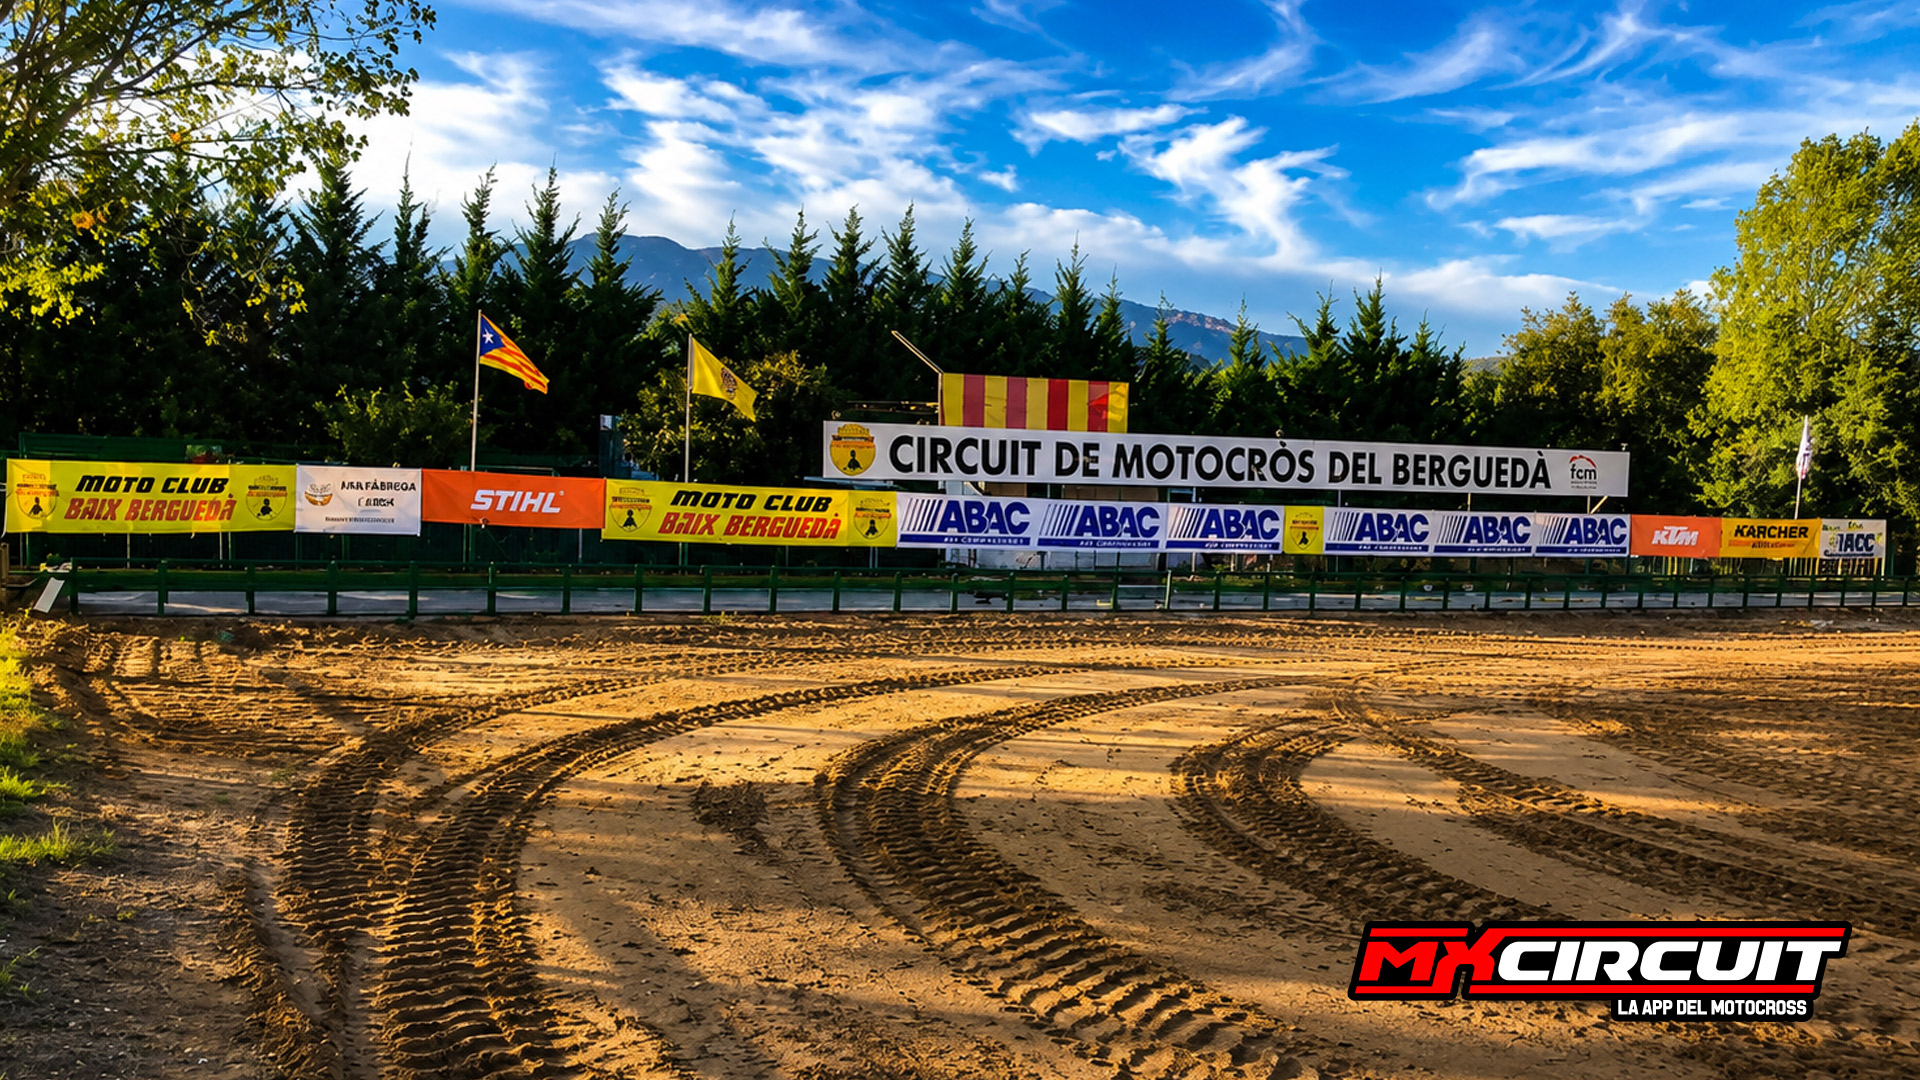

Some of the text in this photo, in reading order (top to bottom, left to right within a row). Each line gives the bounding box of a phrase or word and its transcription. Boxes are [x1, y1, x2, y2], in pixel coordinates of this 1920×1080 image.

[889, 435, 1552, 490] CIRCUIT DE MOTOCRÒS DEL BERGUEDÀ
[1570, 463, 1597, 480] fcm
[75, 474, 157, 493] MOTO
[161, 477, 230, 494] CLUB
[64, 493, 237, 522] BAIX BERGUEDÀ
[470, 489, 561, 513] STIHL
[670, 490, 757, 510] MOTO
[763, 494, 833, 512] CLUB
[658, 511, 721, 535] BAIX
[723, 512, 842, 539] BERGUEDÀ
[937, 500, 1031, 535] ABAC
[1074, 505, 1160, 538] ABAC
[1199, 507, 1280, 540] ABAC
[1355, 512, 1429, 543] ABAC
[1463, 515, 1531, 545] ABAC
[1563, 517, 1628, 546] ABAC
[1651, 525, 1699, 546] KTM
